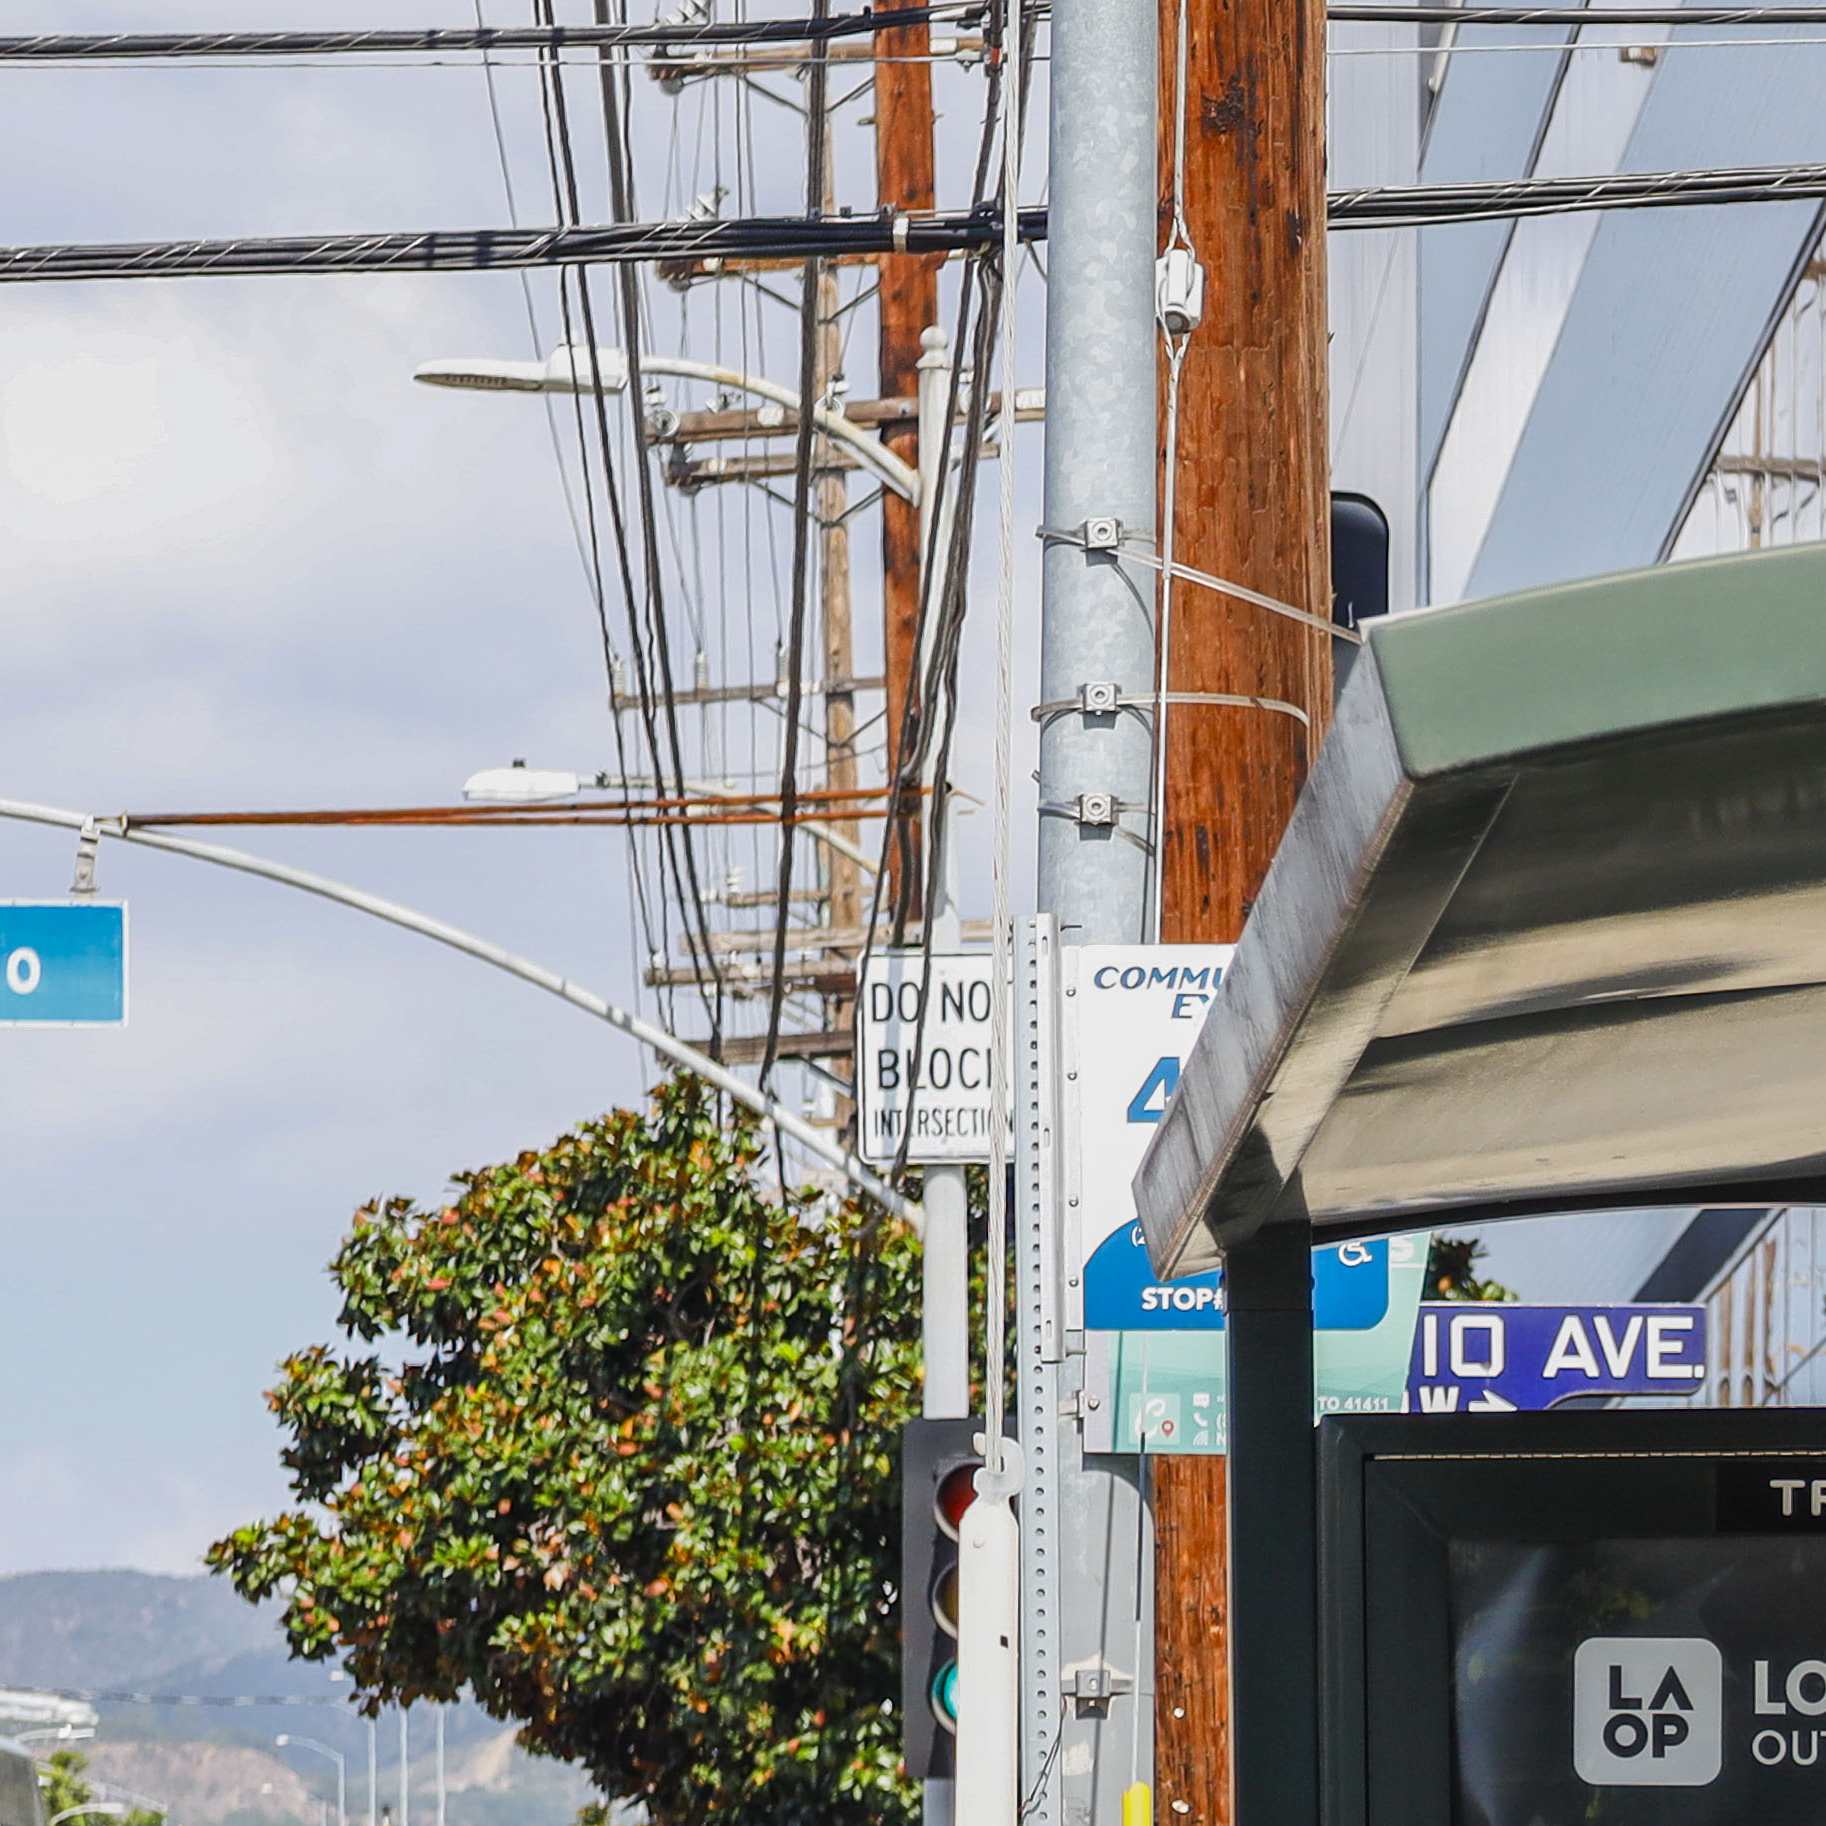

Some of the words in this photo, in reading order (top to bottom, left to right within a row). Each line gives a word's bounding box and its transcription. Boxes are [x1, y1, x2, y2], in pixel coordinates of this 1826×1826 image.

[871, 980, 923, 1023] DO
[1541, 1314, 1706, 1379] AVE.
[1343, 1396, 1389, 1411] 41411
[1609, 1665, 1694, 1710] LA
[1603, 1713, 1689, 1758] OP
